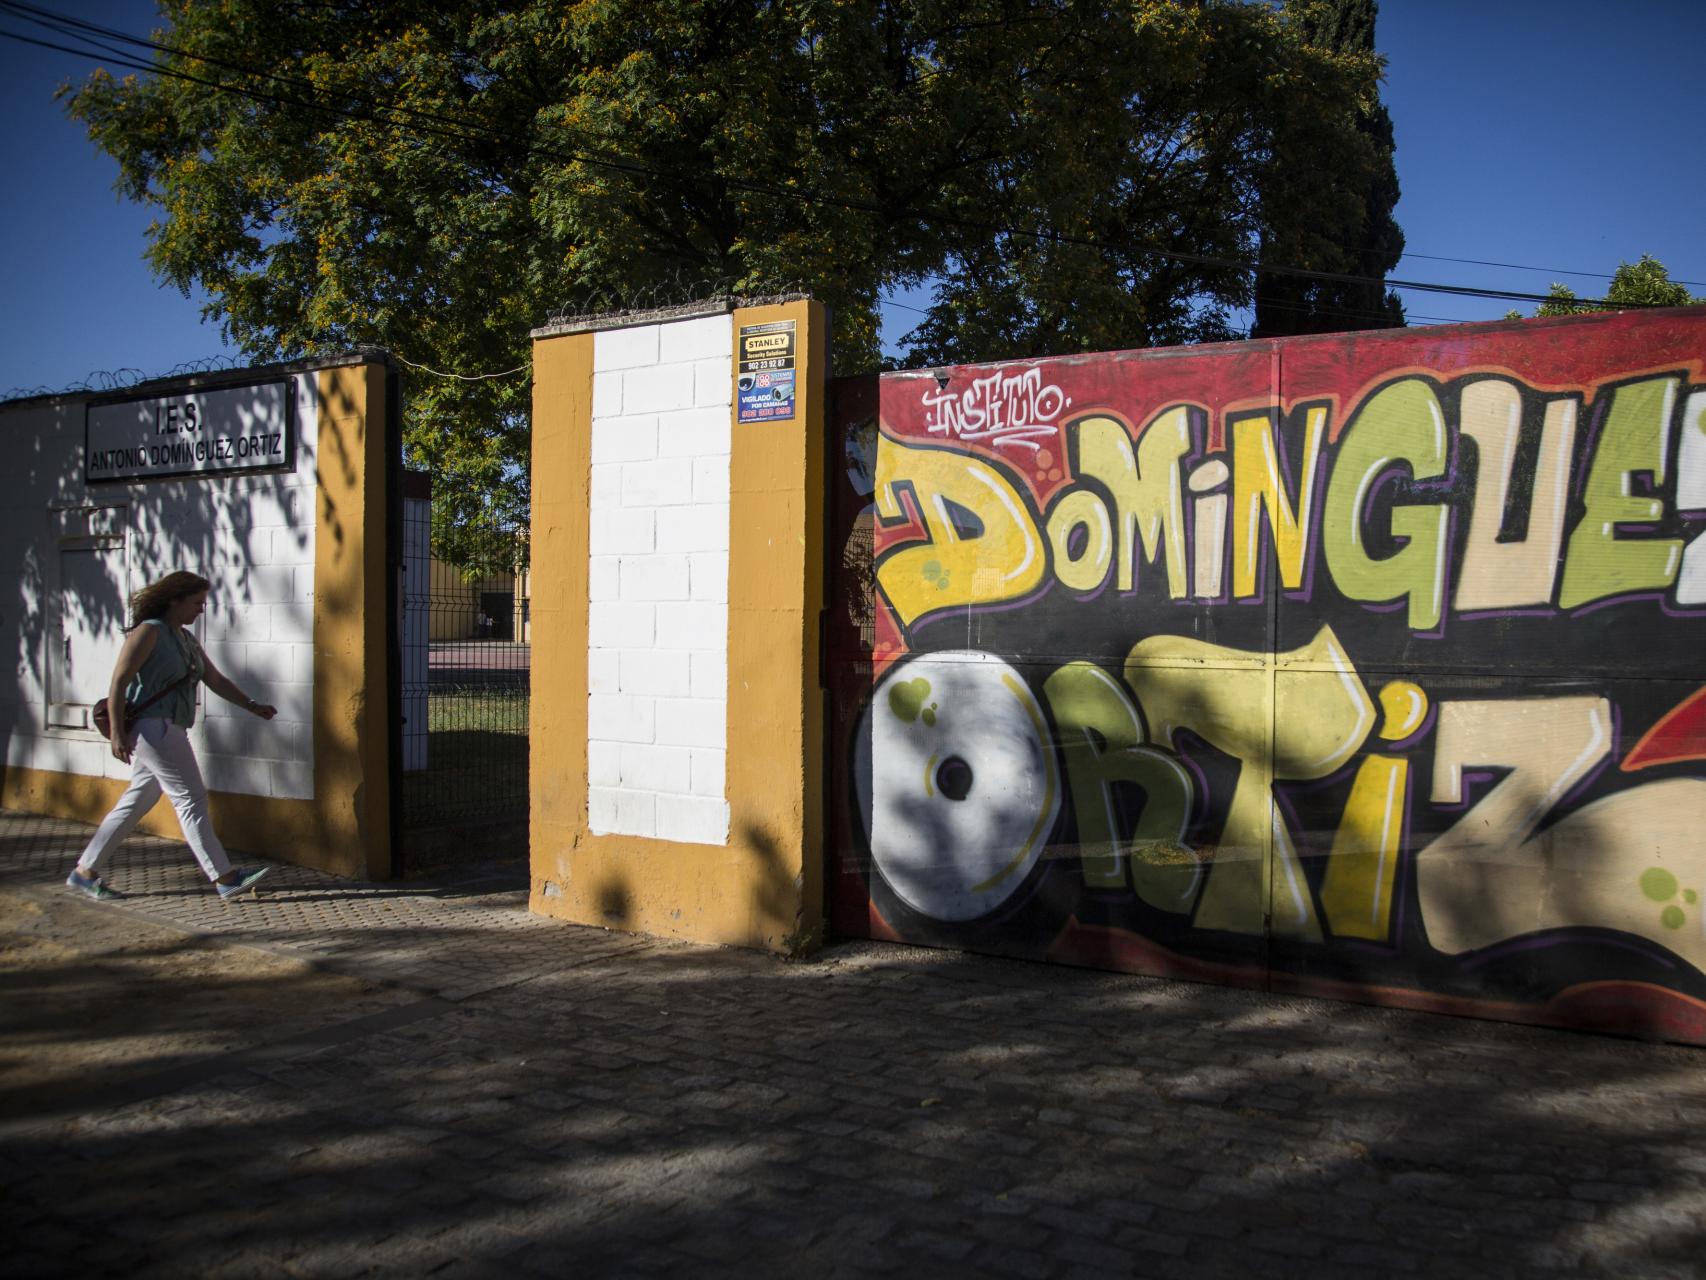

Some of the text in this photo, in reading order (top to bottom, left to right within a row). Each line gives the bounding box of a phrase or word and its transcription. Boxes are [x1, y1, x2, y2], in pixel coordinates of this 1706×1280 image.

[748, 337, 786, 349] STANLEY
[748, 362, 759, 370] 902
[741, 394, 771, 403] VIGILADO
[156, 402, 202, 435] I.E.S.
[90, 433, 282, 471] ANTONIO DOMÍNGUEZ ORTIZ
